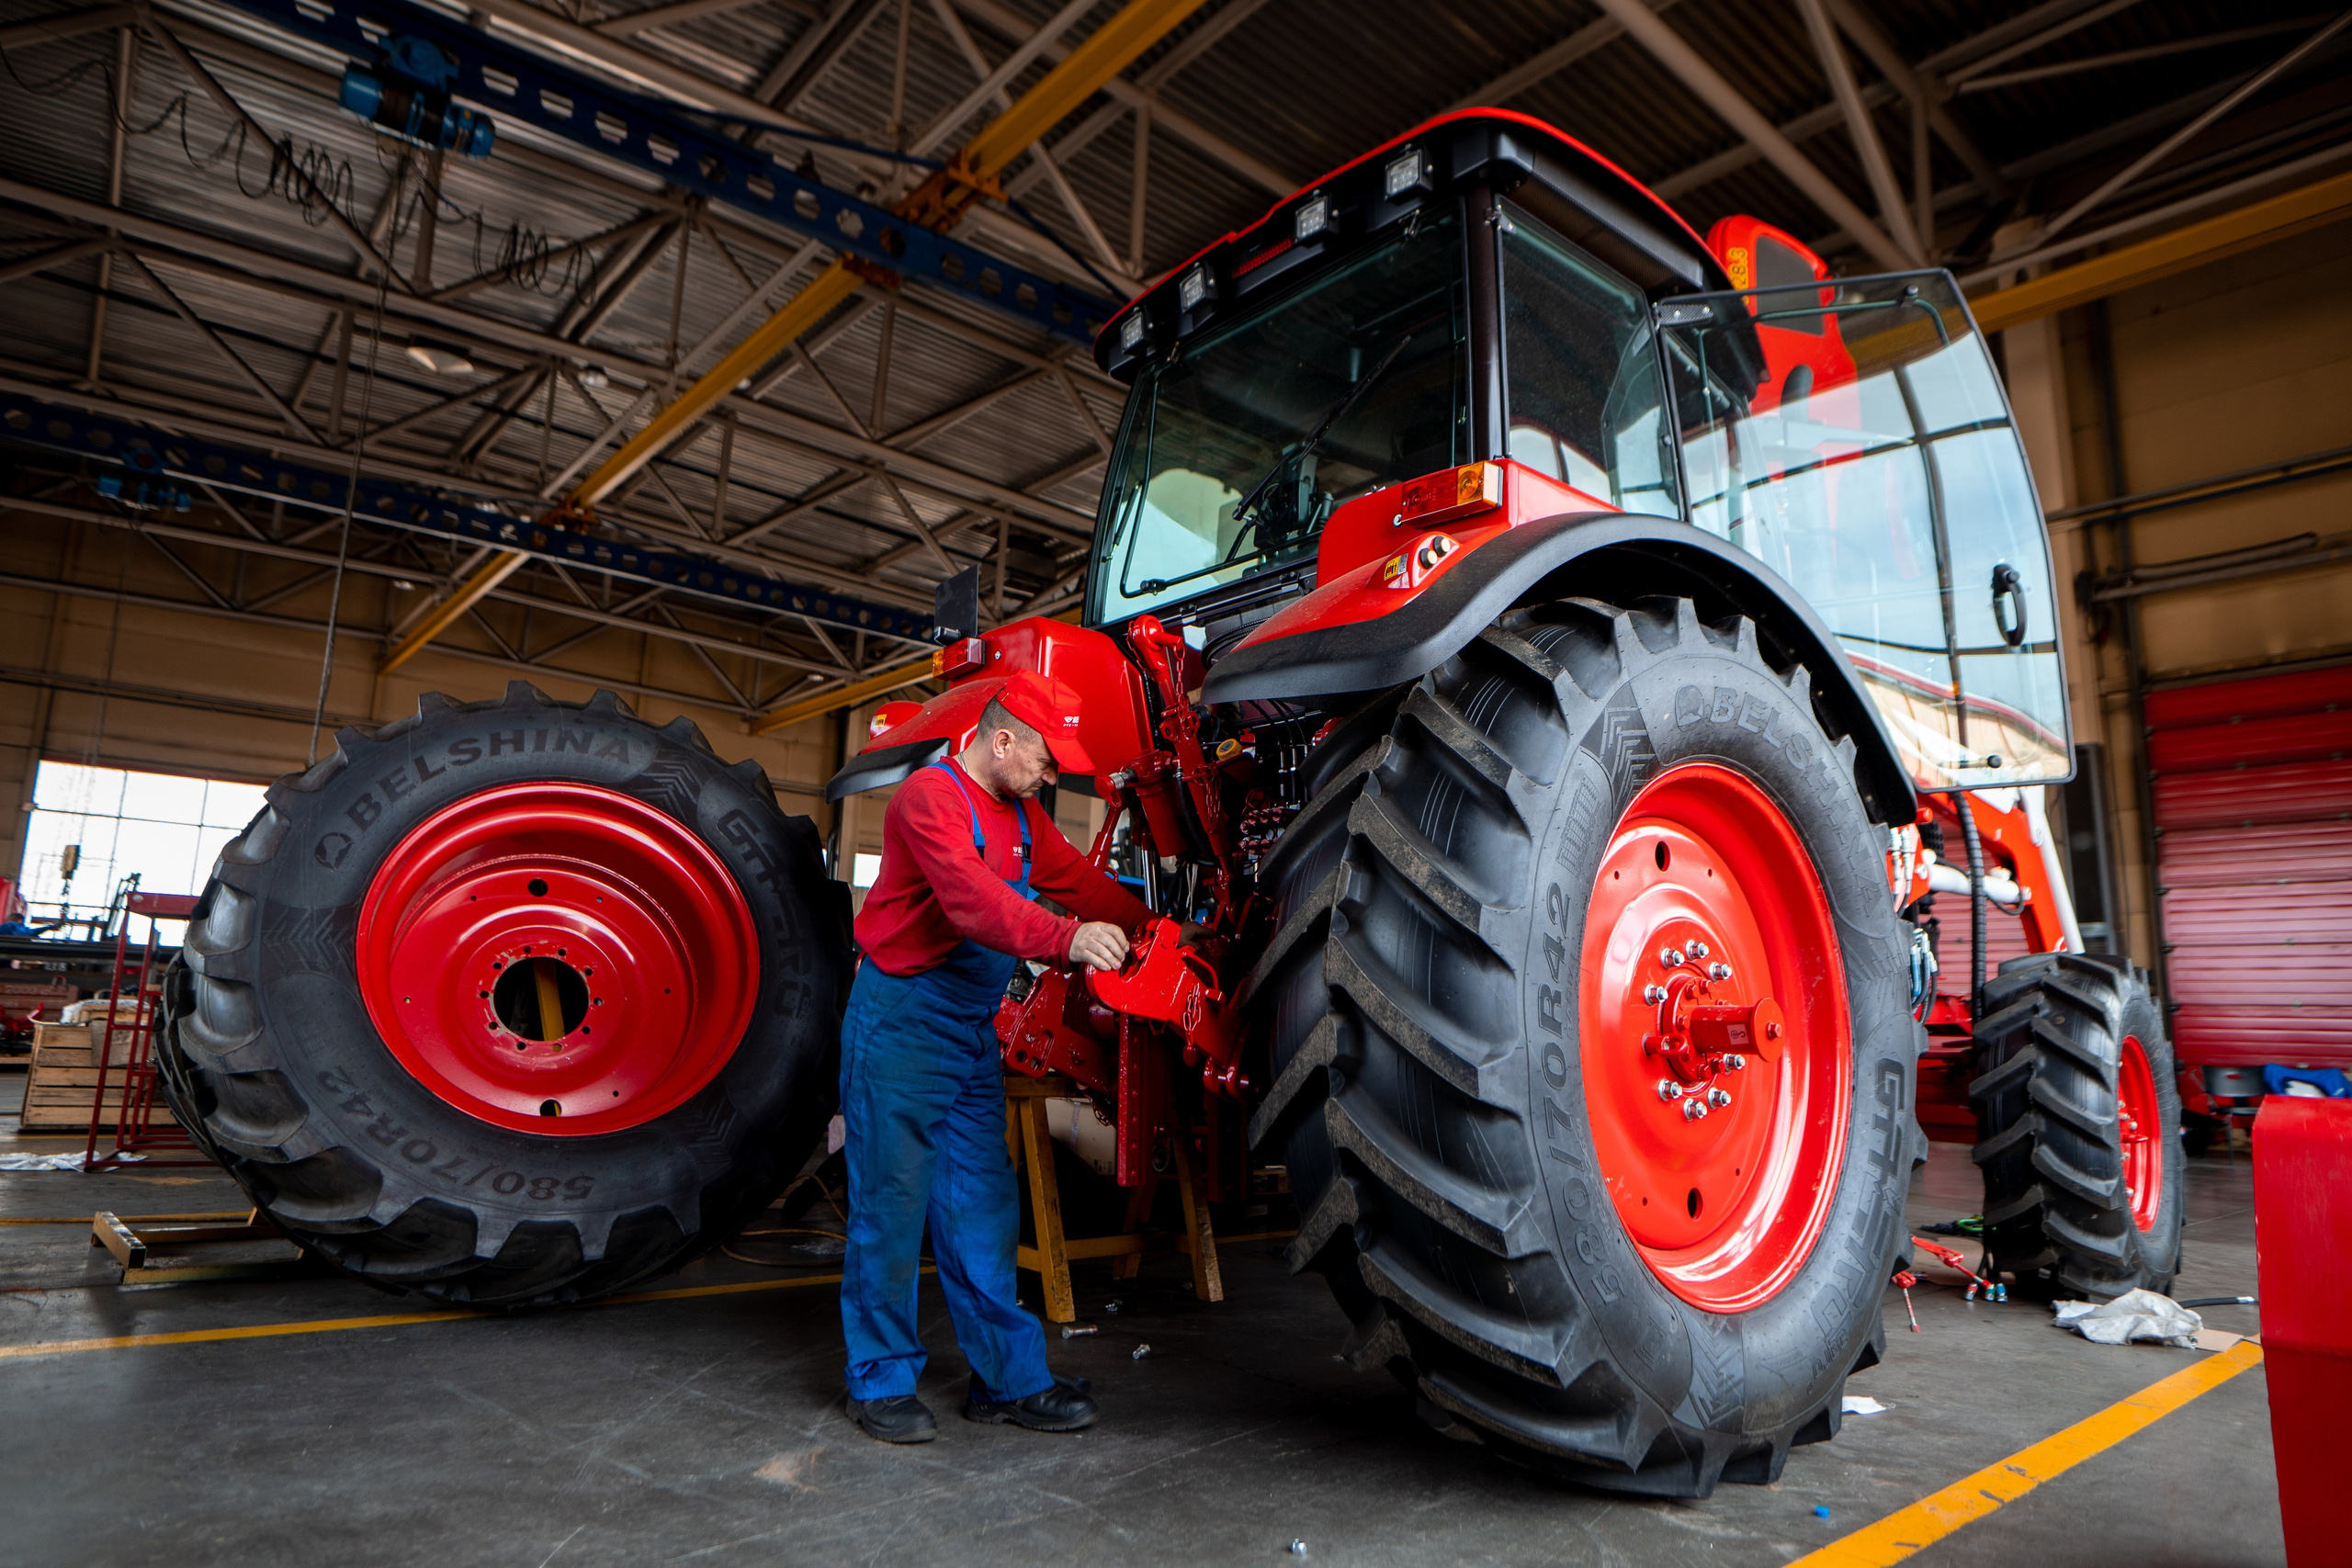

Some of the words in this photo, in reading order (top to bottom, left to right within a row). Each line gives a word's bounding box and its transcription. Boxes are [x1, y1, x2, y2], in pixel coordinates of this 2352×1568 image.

[345, 728, 631, 834] BELSHINA
[1710, 686, 1883, 918] BELSHINA
[316, 1066, 595, 1201] 580/70R42
[1536, 882, 1626, 1305] 580/70R42
